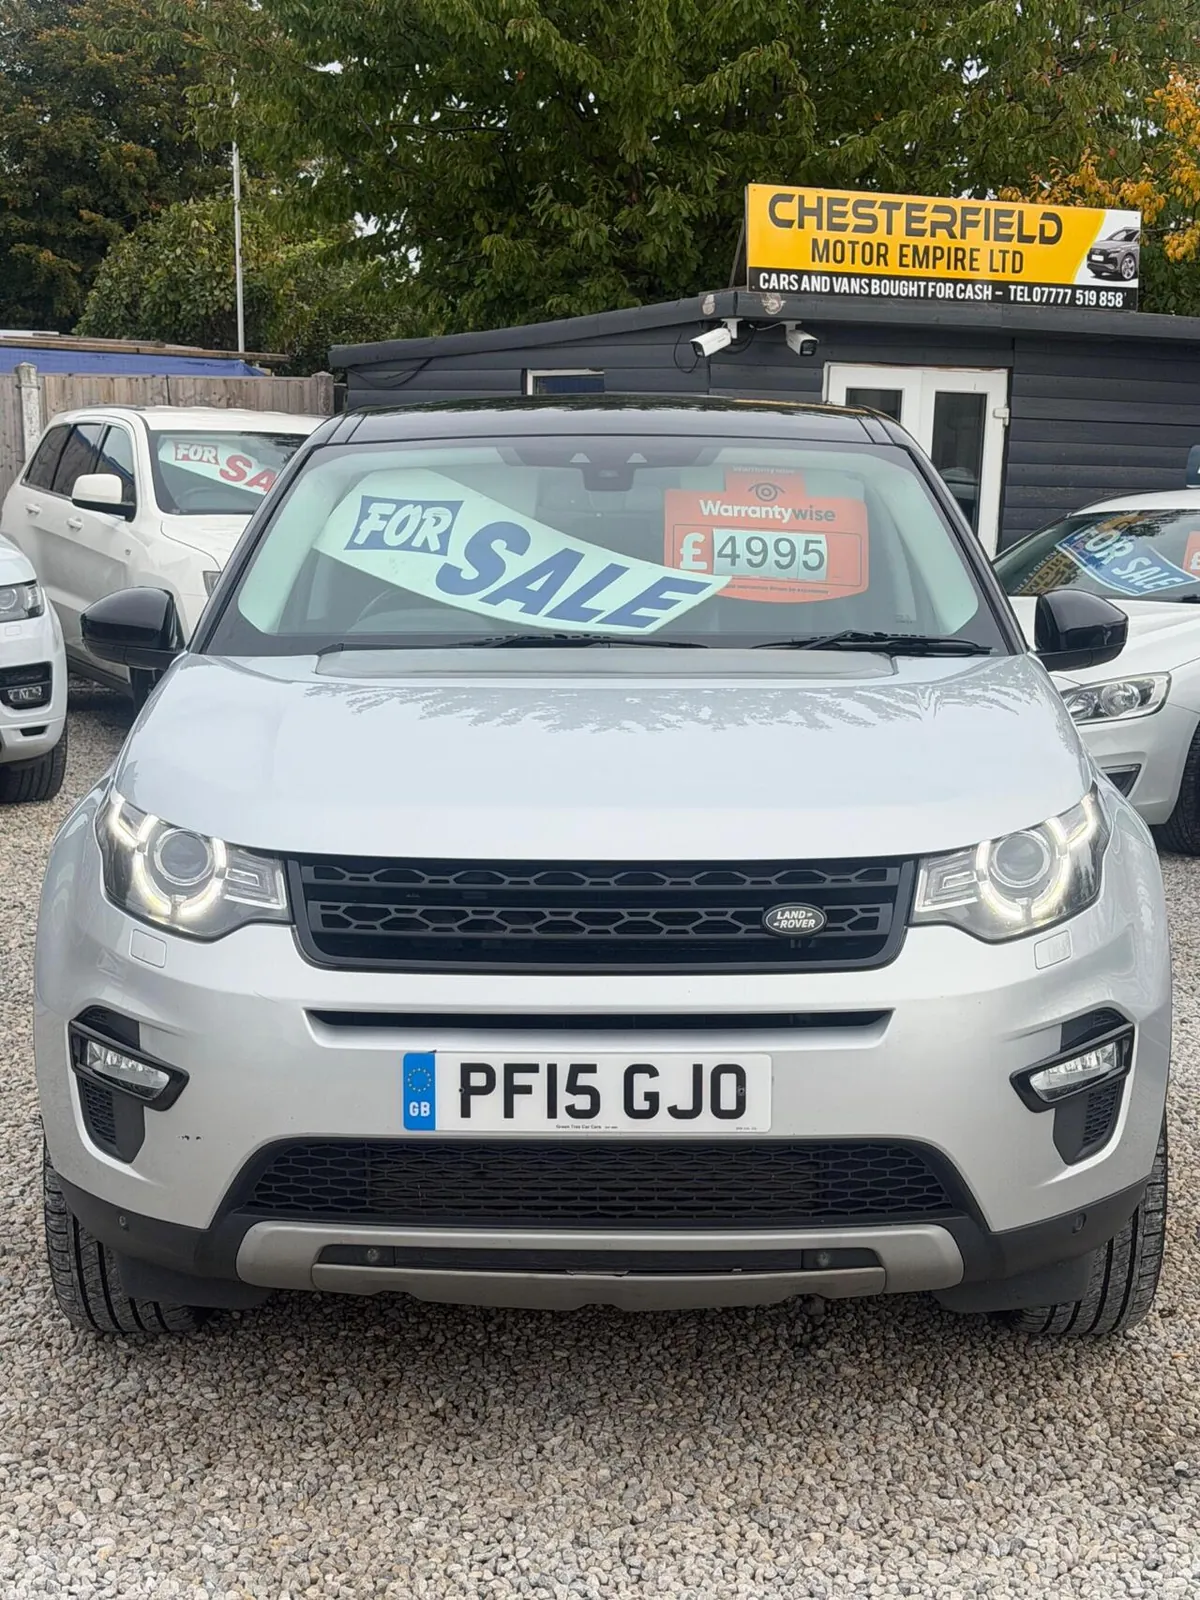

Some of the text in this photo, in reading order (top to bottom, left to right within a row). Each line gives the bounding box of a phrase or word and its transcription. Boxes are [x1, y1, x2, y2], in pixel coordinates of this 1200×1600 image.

[768, 192, 1063, 245] CHESTERFIELD
[811, 237, 1024, 274] MOTOR EMPIRE LTD
[759, 272, 799, 291] CARS
[800, 274, 830, 293] AND
[832, 275, 872, 295] VANS
[871, 278, 927, 298] BOUGHT
[927, 281, 954, 299] FOR
[956, 282, 992, 300] CASH
[1008, 285, 1031, 302] TEL
[1032, 286, 1072, 304] 07777
[1075, 288, 1097, 306] 519
[1099, 290, 1123, 308] 858
[175, 443, 218, 464] FOR
[699, 499, 836, 523] Warrantywise
[352, 500, 714, 628] FOR SALE
[1074, 525, 1134, 566] FOR
[1111, 556, 1185, 590] SALE
[776, 910, 806, 920] LAND
[779, 919, 816, 929] ROVER
[409, 1101, 431, 1117] GB
[459, 1062, 747, 1120] PF15 GJO
